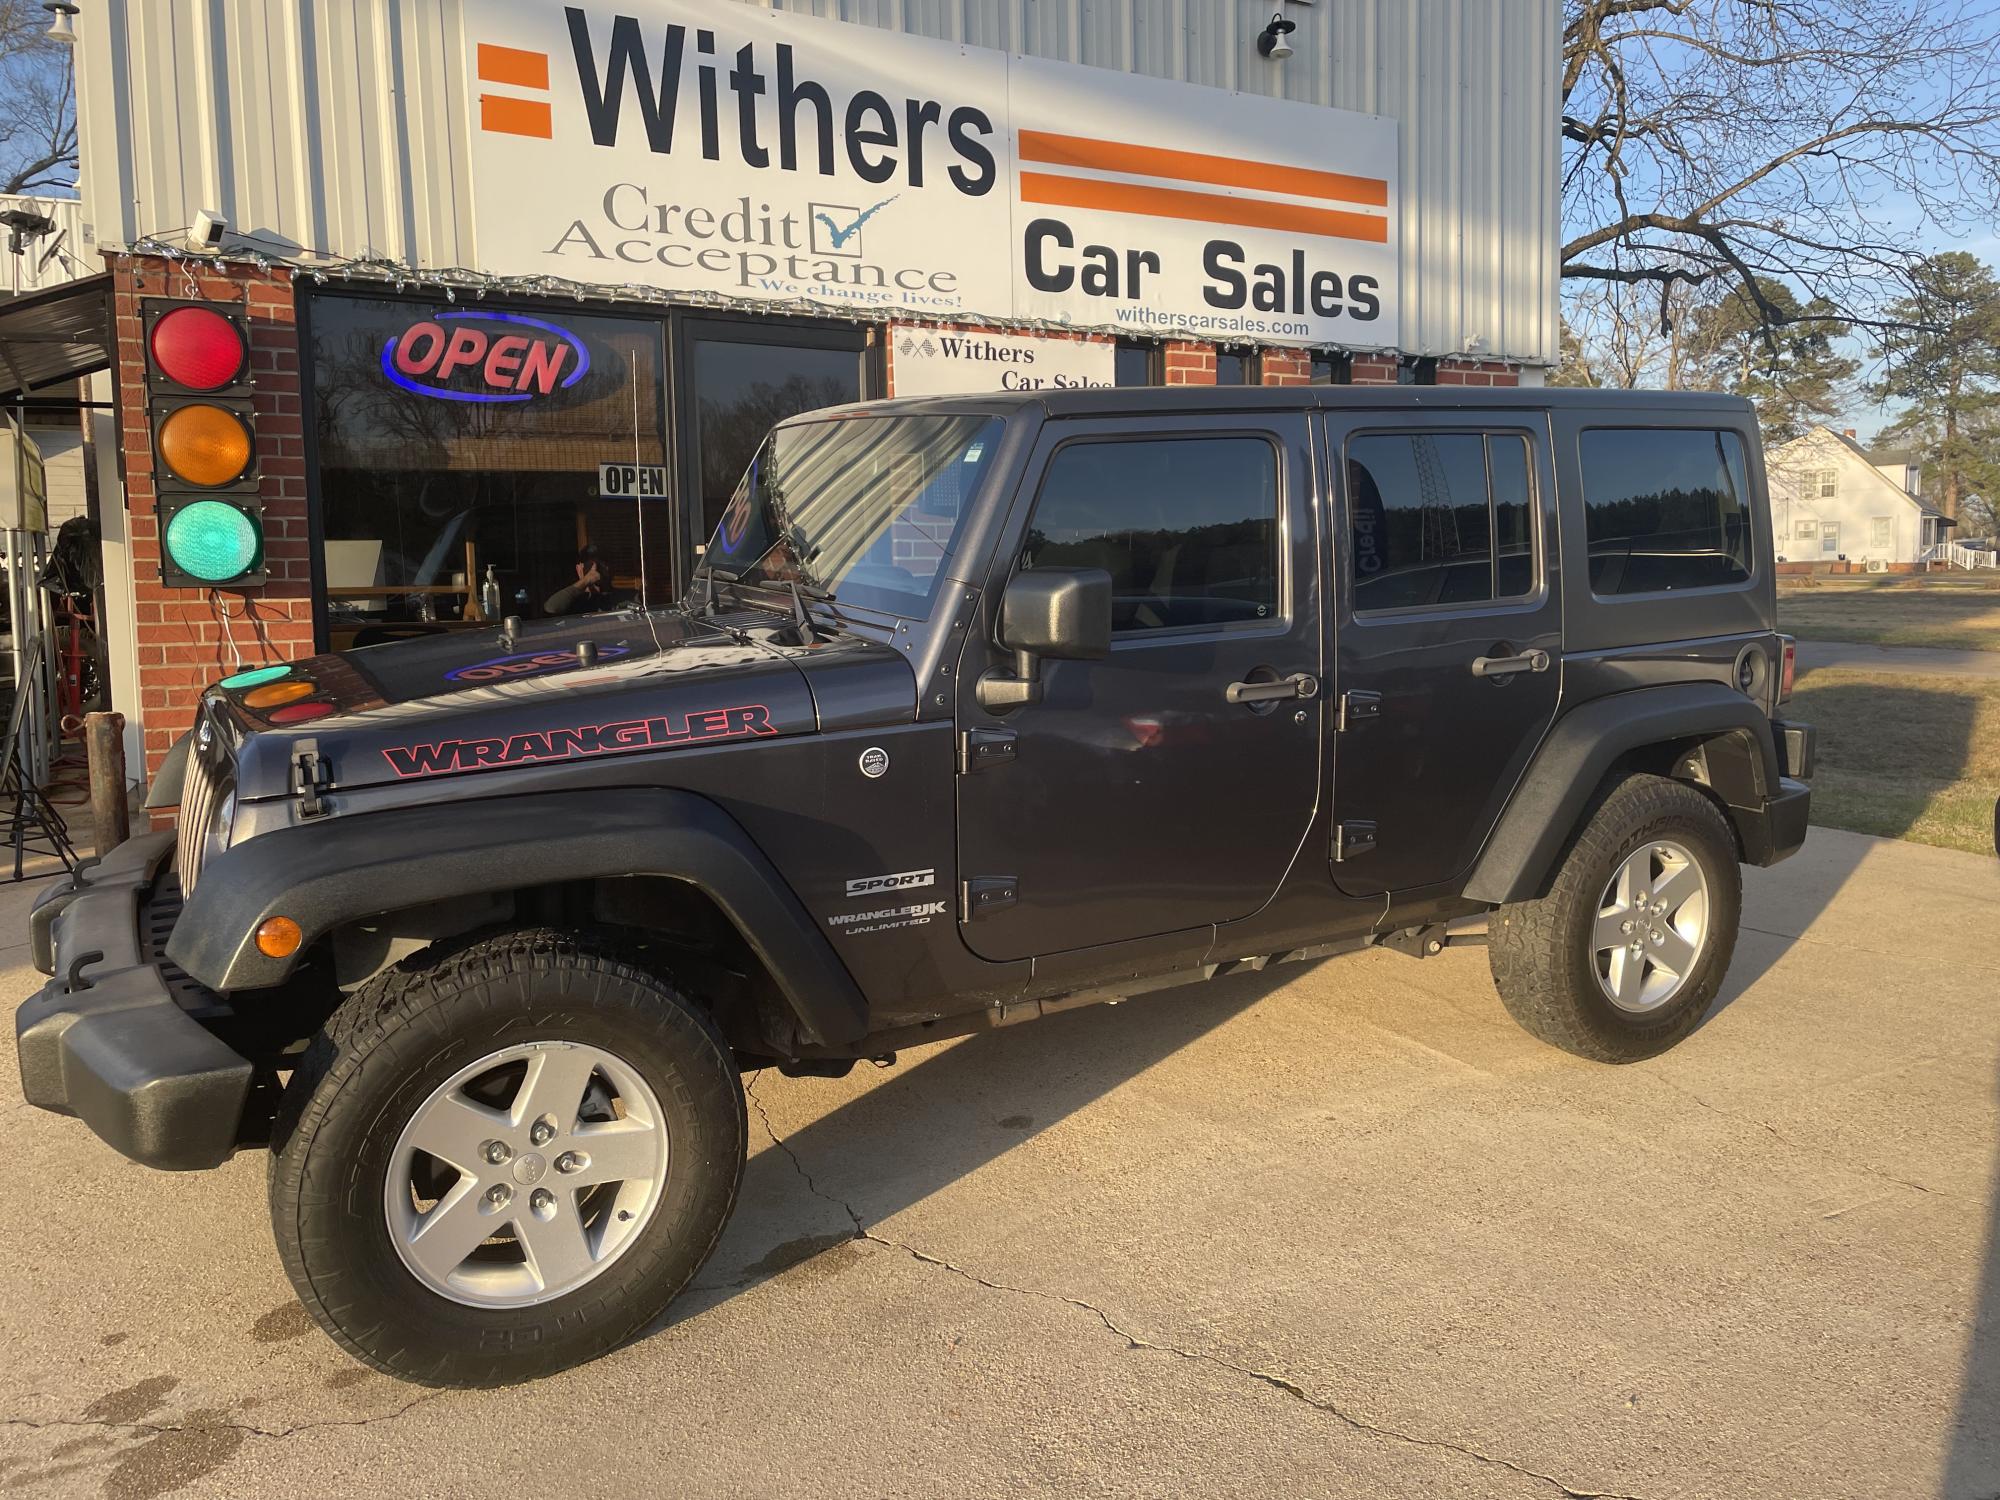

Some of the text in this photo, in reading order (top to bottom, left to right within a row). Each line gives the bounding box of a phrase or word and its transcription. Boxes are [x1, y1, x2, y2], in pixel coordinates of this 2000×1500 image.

[564, 6, 996, 197] Withers
[602, 182, 803, 250] Credit
[541, 219, 958, 293] Acceptance
[1024, 218, 1380, 321] Car Sales
[760, 278, 962, 308] We change lives!
[1116, 306, 1310, 336] witherscarsales.com
[396, 321, 570, 395] OPEN
[938, 337, 1035, 364] Withers
[1001, 370, 1044, 392] Car
[605, 466, 664, 496] OPEN
[381, 704, 778, 778] WRANGLER
[848, 871, 935, 894] SPORT
[845, 917, 931, 935] UNLIMITED
